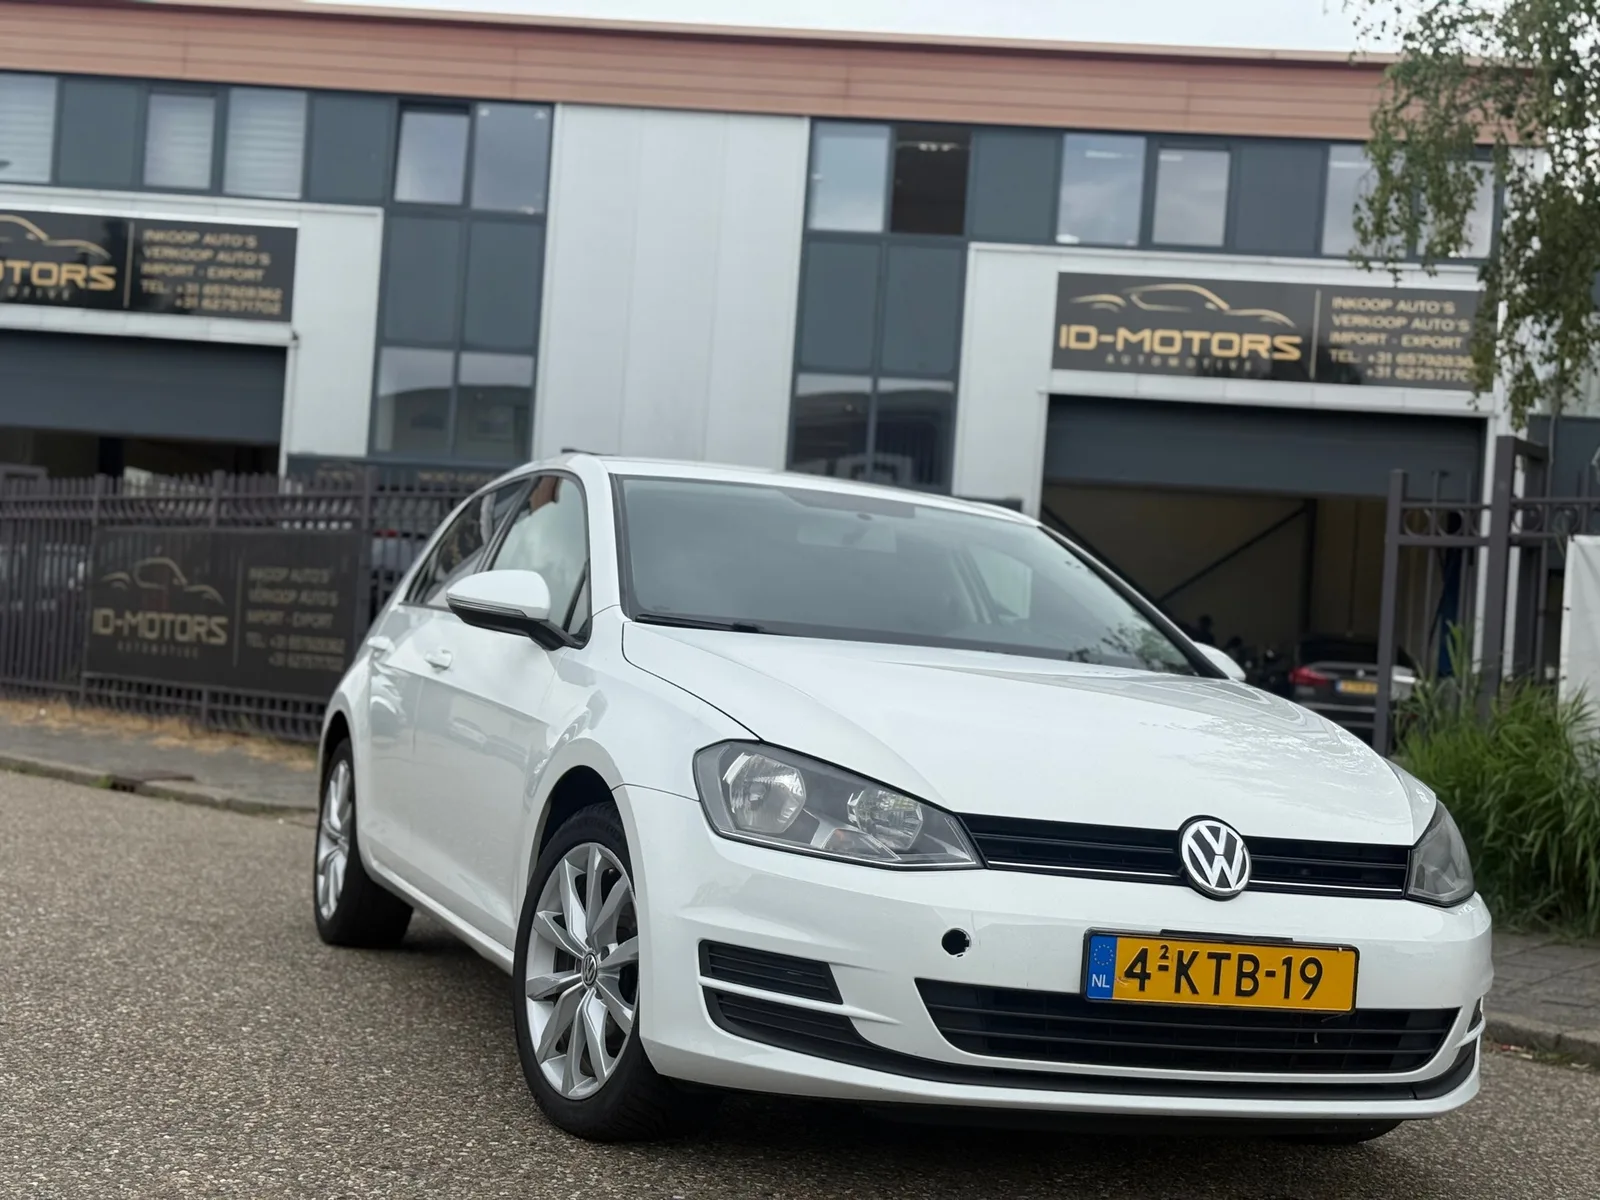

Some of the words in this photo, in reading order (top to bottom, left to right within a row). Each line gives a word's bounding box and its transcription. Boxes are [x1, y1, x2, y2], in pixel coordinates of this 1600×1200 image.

[0, 259, 118, 291] TORS
[1332, 296, 1393, 311] INKOOP
[1396, 299, 1456, 315] AUTO'S
[1332, 313, 1407, 329] VERKOOP
[1410, 317, 1470, 333] AUTO'S
[1059, 323, 1303, 361] ID-MOTORS
[1329, 331, 1388, 346] IMPORT
[1401, 334, 1464, 349] EXPORT
[92, 607, 229, 645] ID-MOTORS
[1091, 973, 1111, 988] NL
